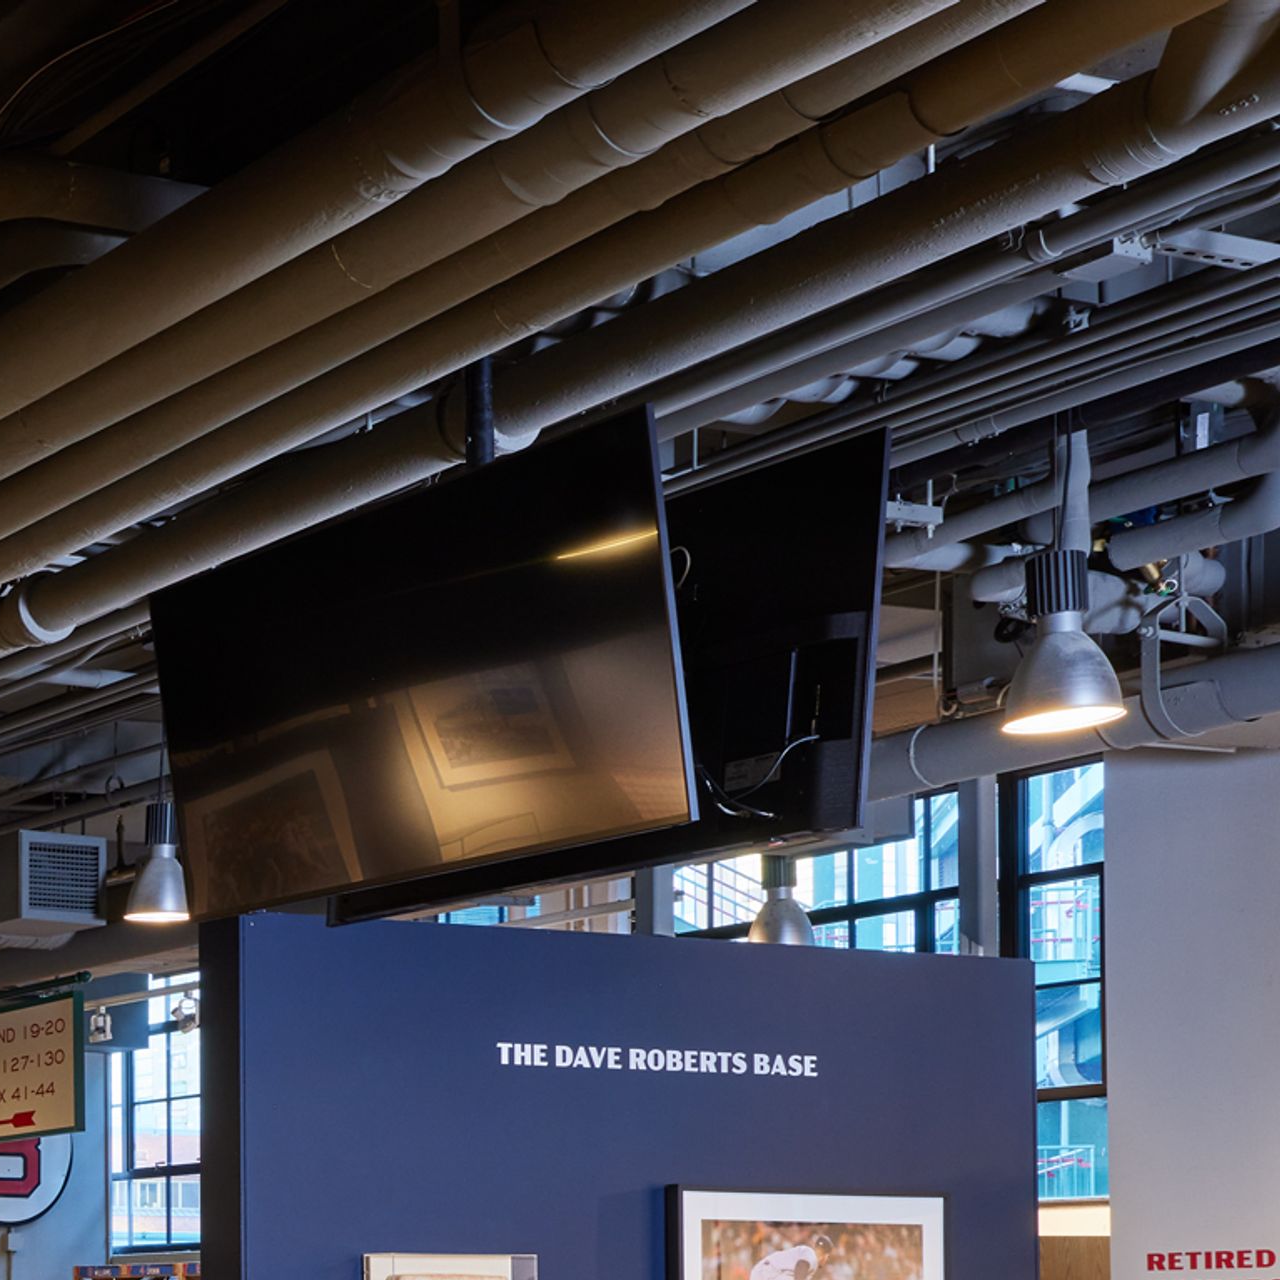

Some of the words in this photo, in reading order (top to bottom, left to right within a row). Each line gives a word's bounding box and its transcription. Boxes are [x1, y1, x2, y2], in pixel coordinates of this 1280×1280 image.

[23, 1018, 66, 1040] 19-20
[2, 1049, 66, 1074] 127-130
[496, 1041, 549, 1067] THE
[555, 1044, 623, 1070] DAVE
[628, 1047, 748, 1075] ROBERTS
[753, 1053, 819, 1077] BASE
[11, 1081, 56, 1101] 41-44
[1146, 1249, 1277, 1271] RETIRED
